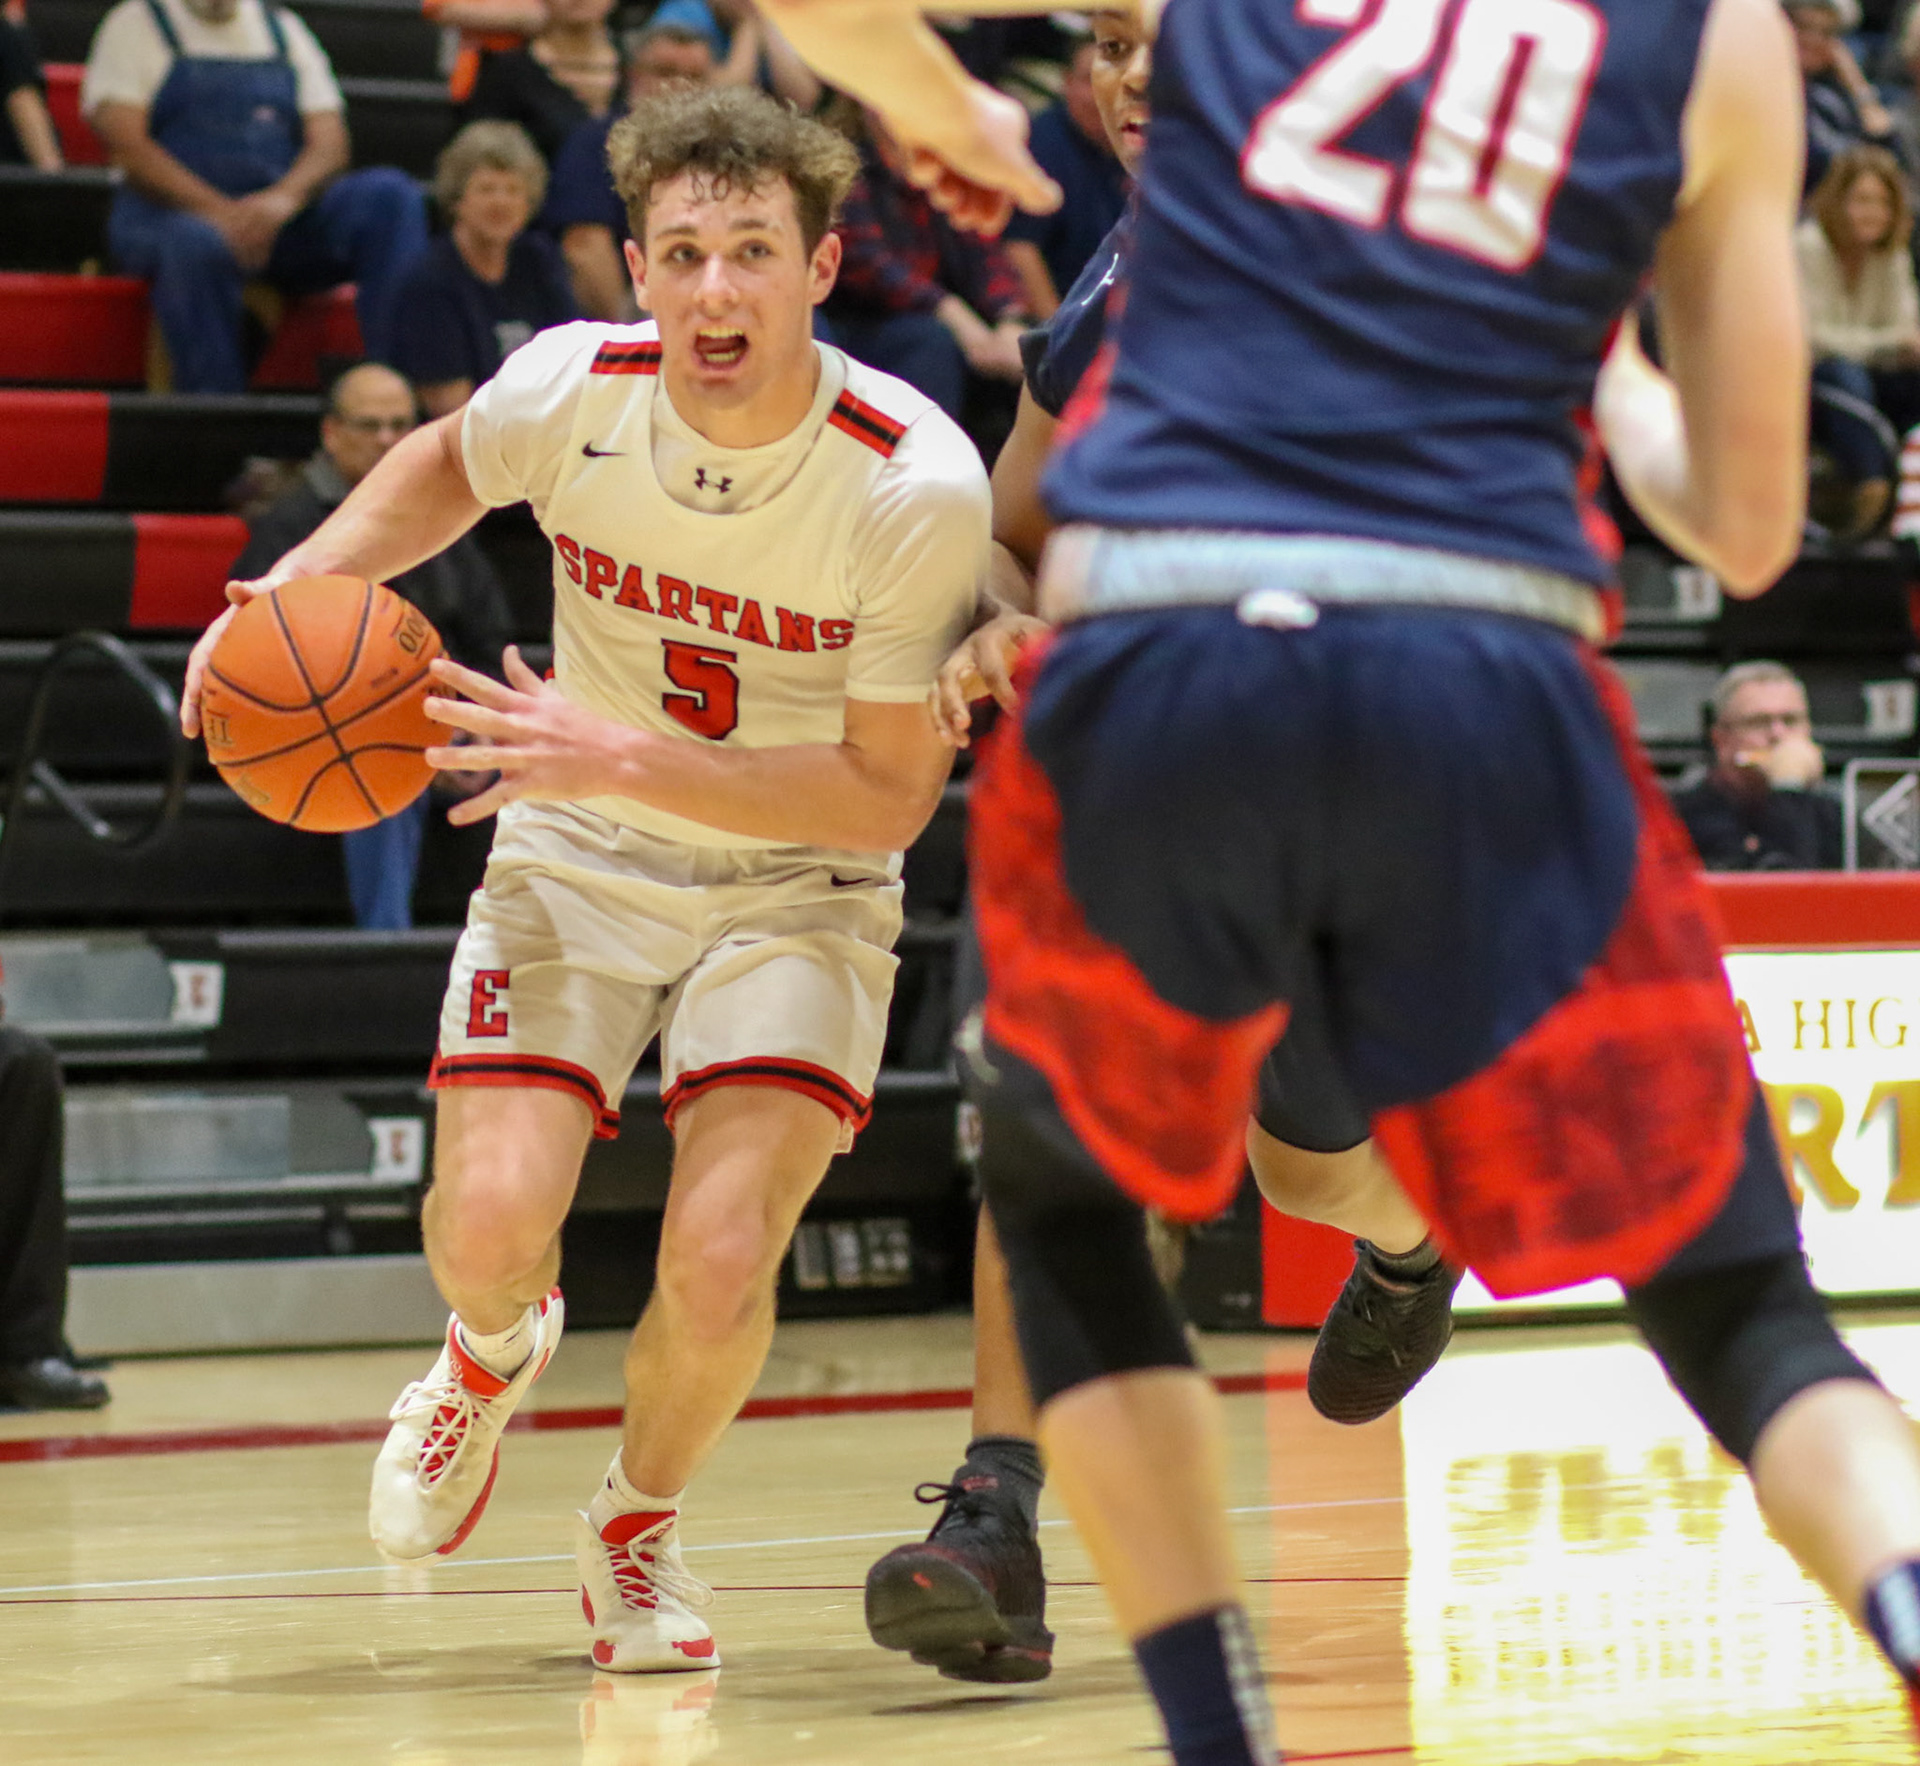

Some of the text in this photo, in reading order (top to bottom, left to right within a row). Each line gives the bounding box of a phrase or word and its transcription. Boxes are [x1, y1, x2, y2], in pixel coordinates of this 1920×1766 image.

[1240, 0, 1608, 275] 20
[555, 533, 856, 653] SPARTANS
[661, 638, 740, 741] 5
[466, 968, 511, 1039] E
